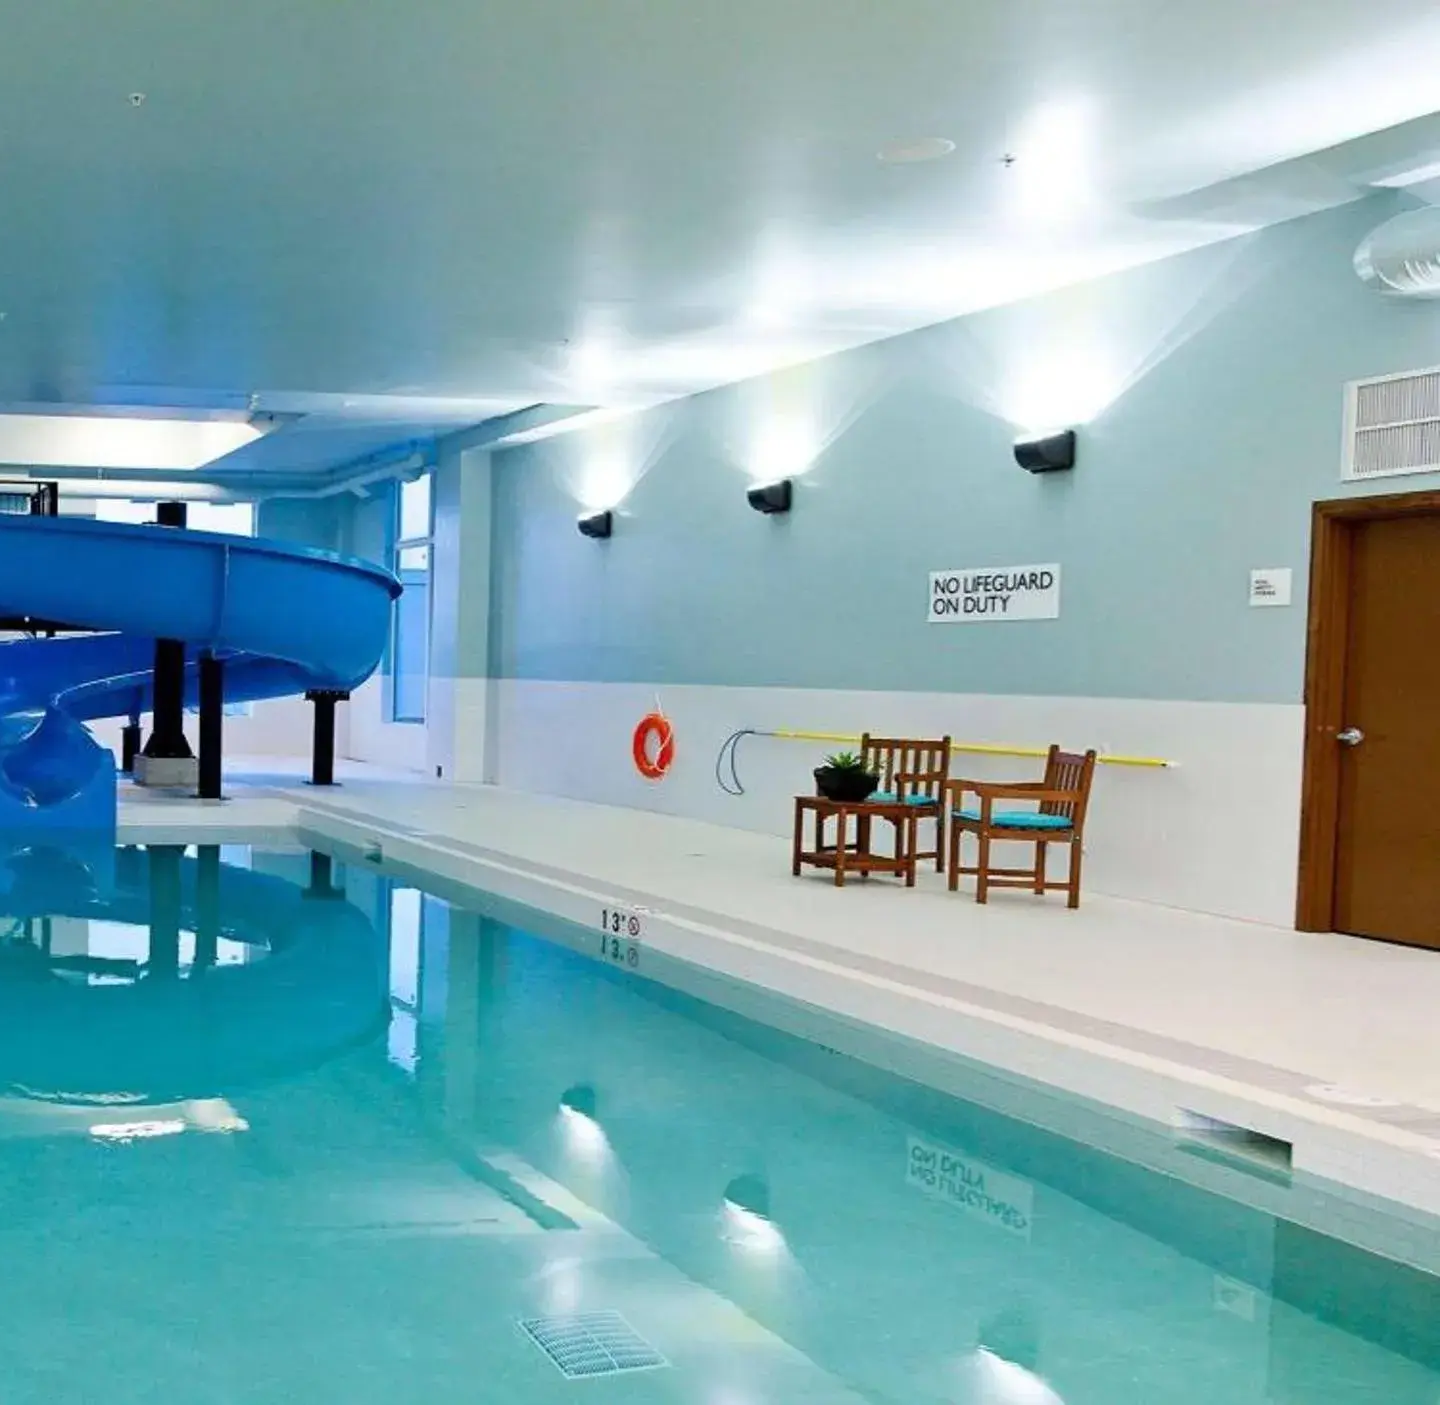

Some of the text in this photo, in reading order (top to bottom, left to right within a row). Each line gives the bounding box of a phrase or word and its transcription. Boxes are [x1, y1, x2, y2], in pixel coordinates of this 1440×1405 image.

[934, 571, 1053, 595] NO LIFEGUARD
[932, 595, 1011, 615] ON DUTY
